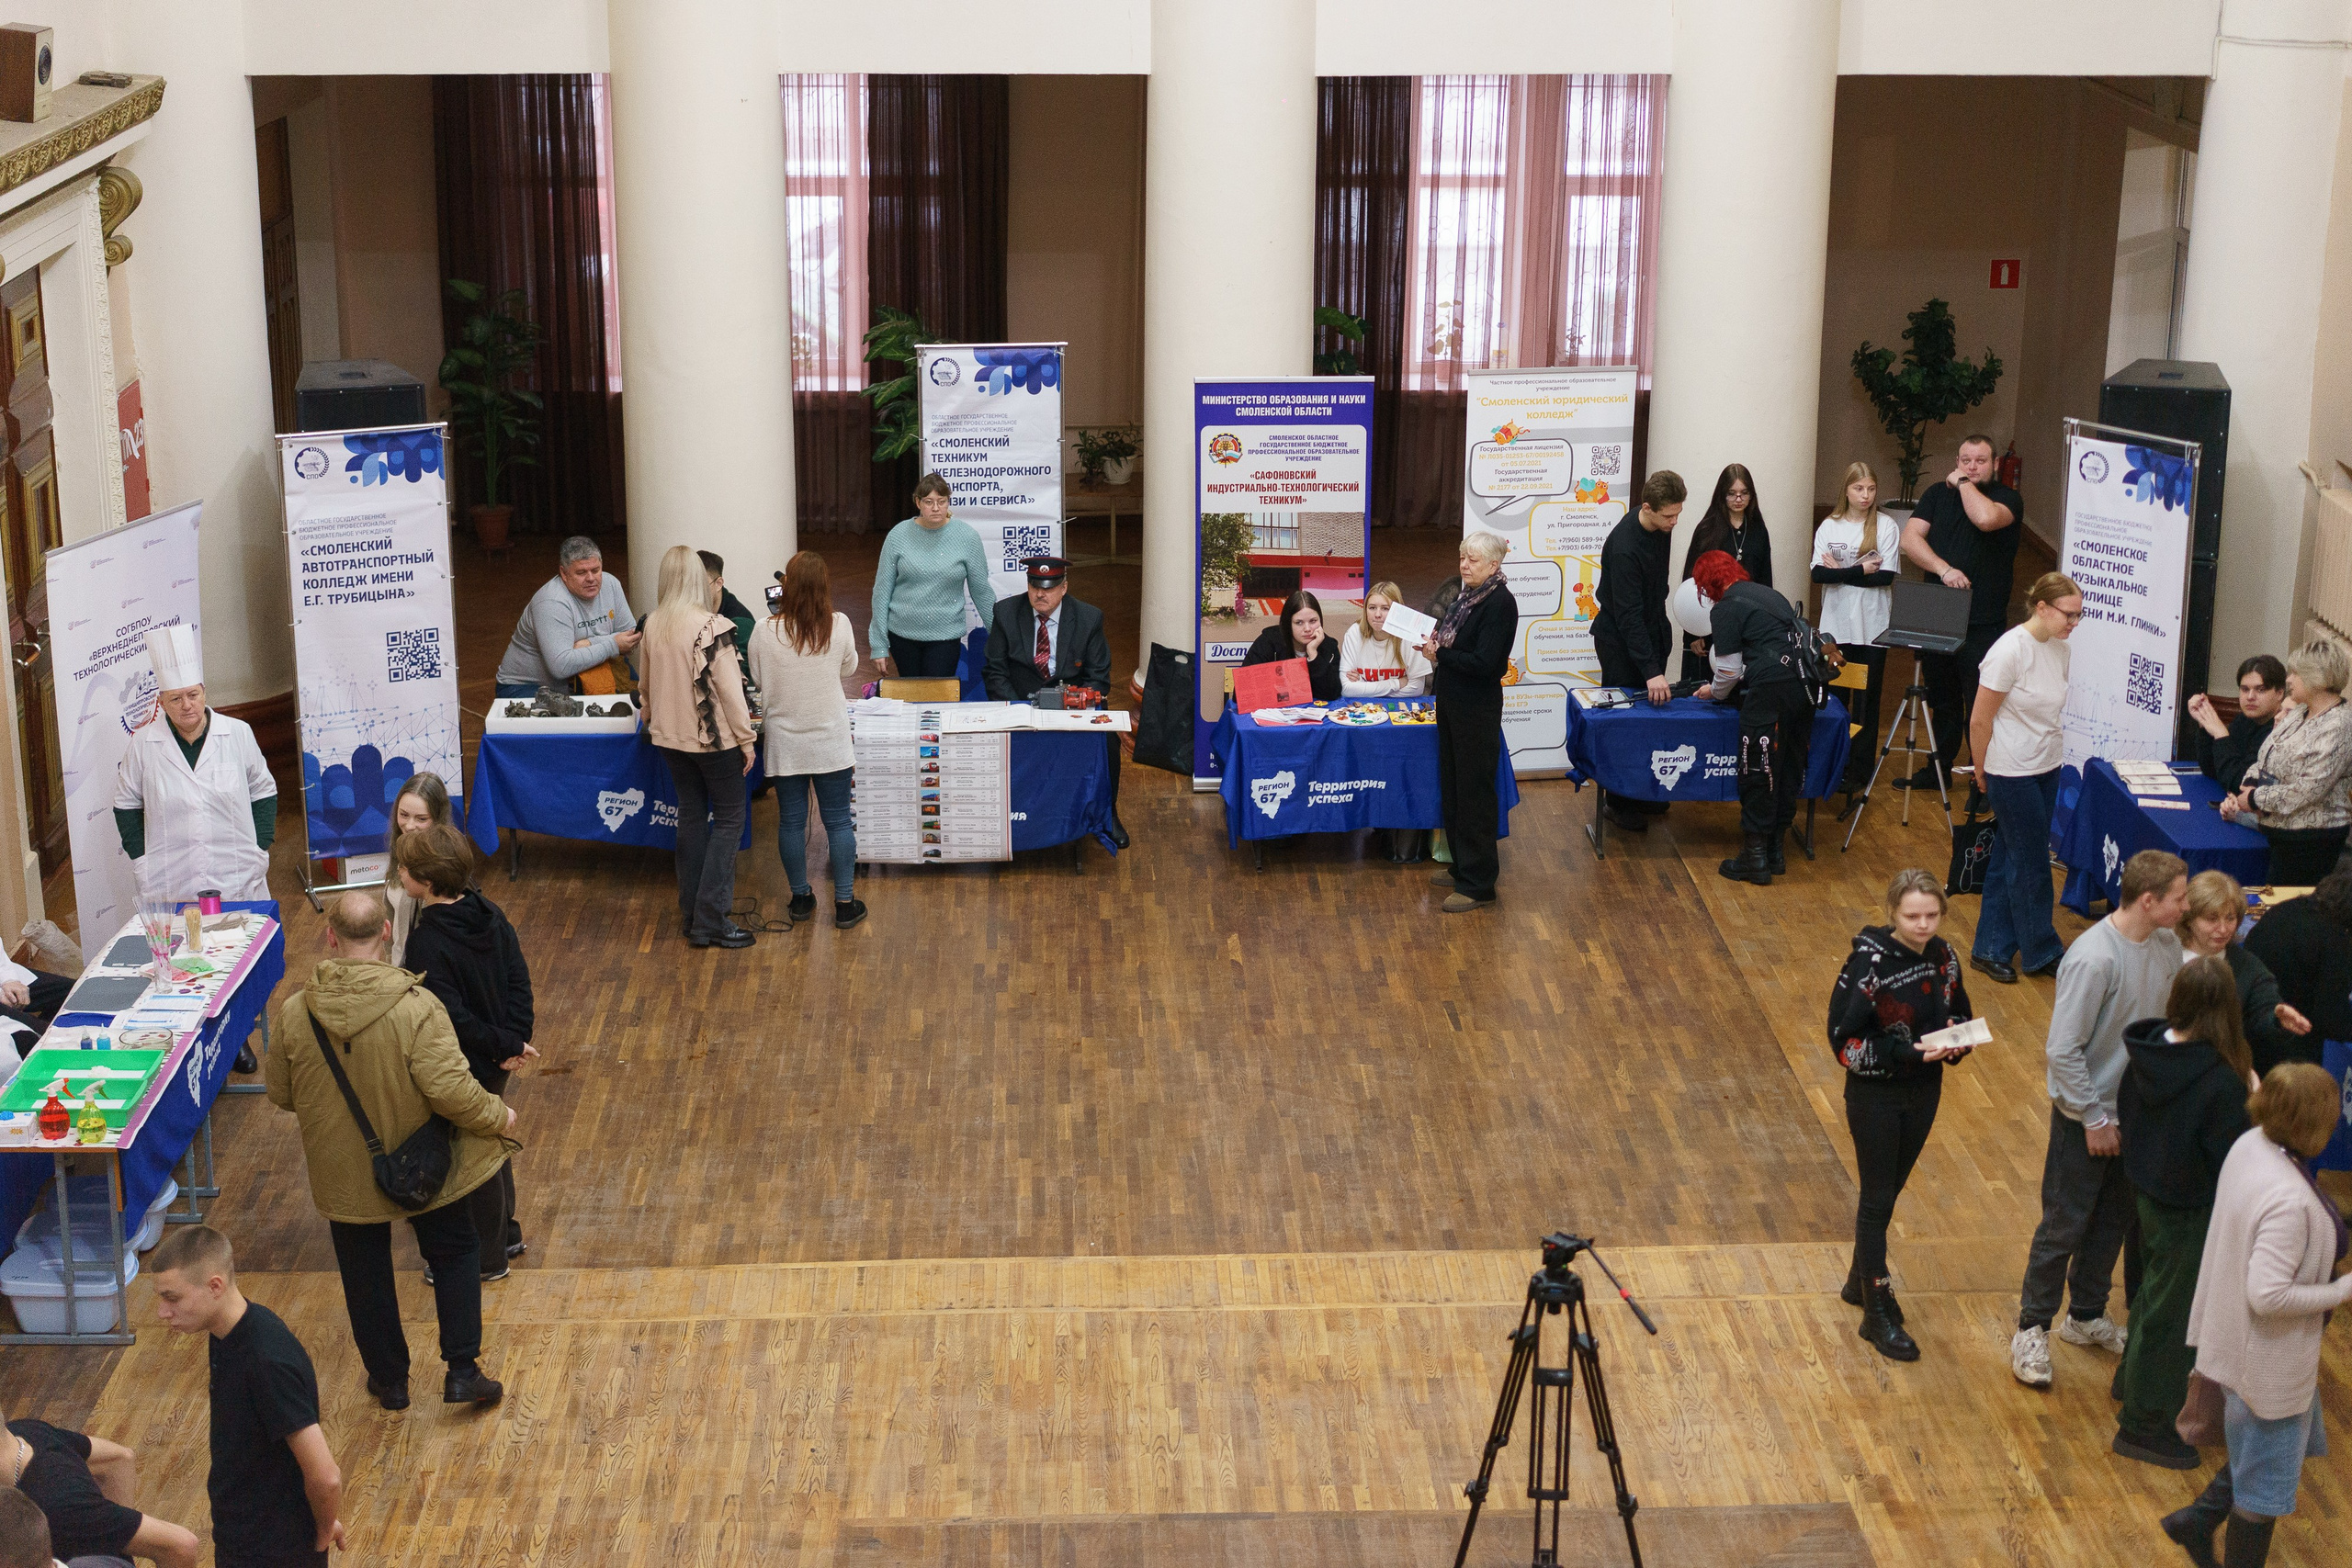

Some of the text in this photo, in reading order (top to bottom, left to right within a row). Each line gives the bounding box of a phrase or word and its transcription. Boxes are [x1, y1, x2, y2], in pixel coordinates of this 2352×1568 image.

[1202, 395, 1366, 405] МИНИСТЕРСТВО ОБРАЗОВАНИЯ И НАУКИ
[1553, 393, 1629, 407] юридический
[1236, 405, 1332, 416] СМОЛЕНСКОЙ ОБЛАСТИ
[931, 434, 1010, 448] «СМОЛЕНСКИЙ
[931, 452, 988, 463] ТЕХНИКУМ
[932, 466, 1051, 479] ЖЕЛЕЗНОДОРОЖНОГО
[1250, 468, 1317, 480] «САФОНОВСКИЙ
[1494, 468, 1548, 476] Государственная
[947, 481, 1003, 493] НСПОРТА,
[1207, 481, 1360, 494] ИНДУСТРИАЛЬНО-ТЕХНОЛОГИЧЕСКИЙ
[969, 497, 977, 506] И
[980, 494, 1035, 506] СЕРВИСА»
[1259, 495, 1307, 505] ТЕХНИКУМ»
[299, 513, 387, 526] ОБЛАСТНОЕ ГОСУДАРСТВЕННОЕ
[2075, 512, 2153, 532] ГОСУДАРСТВЕННОЕ БЮДЖЕТНОЕ
[299, 519, 398, 534] БЮДЖЕТНОЕ ПРОФЕССИОНАЛЬНОЕ
[2074, 519, 2128, 534] ПРОФЕССИОНАЛЬНОЕ
[299, 527, 394, 541] ОБРАЗОВАТЕЛЬНОЕ УЧРЕЖДЕНИЕ
[2074, 526, 2122, 541] ОБРАЗОВАТЕЛЬНОЕ
[300, 536, 392, 557] «СМОЛЕНСКИЙ
[2074, 540, 2148, 562] «СМОЛЕНСКОЕ
[302, 548, 435, 573] АВТОТРАНСПОРТНЫЙ
[2072, 554, 2134, 576] ОБЛАСТНОЕ
[303, 570, 413, 590] КОЛЛЕДЖ ИМЕНИ
[2071, 570, 2148, 597] МУЗЫКАЛЬНОЕ
[304, 588, 415, 606] Е.Г. ТРУБИЦЫНА»
[2082, 590, 2123, 607] ИЛИЩЕ
[116, 615, 152, 637] СОГБПОУ
[2082, 606, 2166, 637] ЕНИ М.И. ГЛИНКИ»
[1657, 755, 1690, 763] РЕГИОН
[1659, 765, 1678, 776] 67
[1258, 782, 1290, 792] РЕГИОН
[1307, 780, 1386, 793] Территория
[605, 796, 638, 807] РЕГИОН
[1260, 793, 1278, 804] 67
[1307, 793, 1353, 807] успеха
[605, 806, 624, 817] 67
